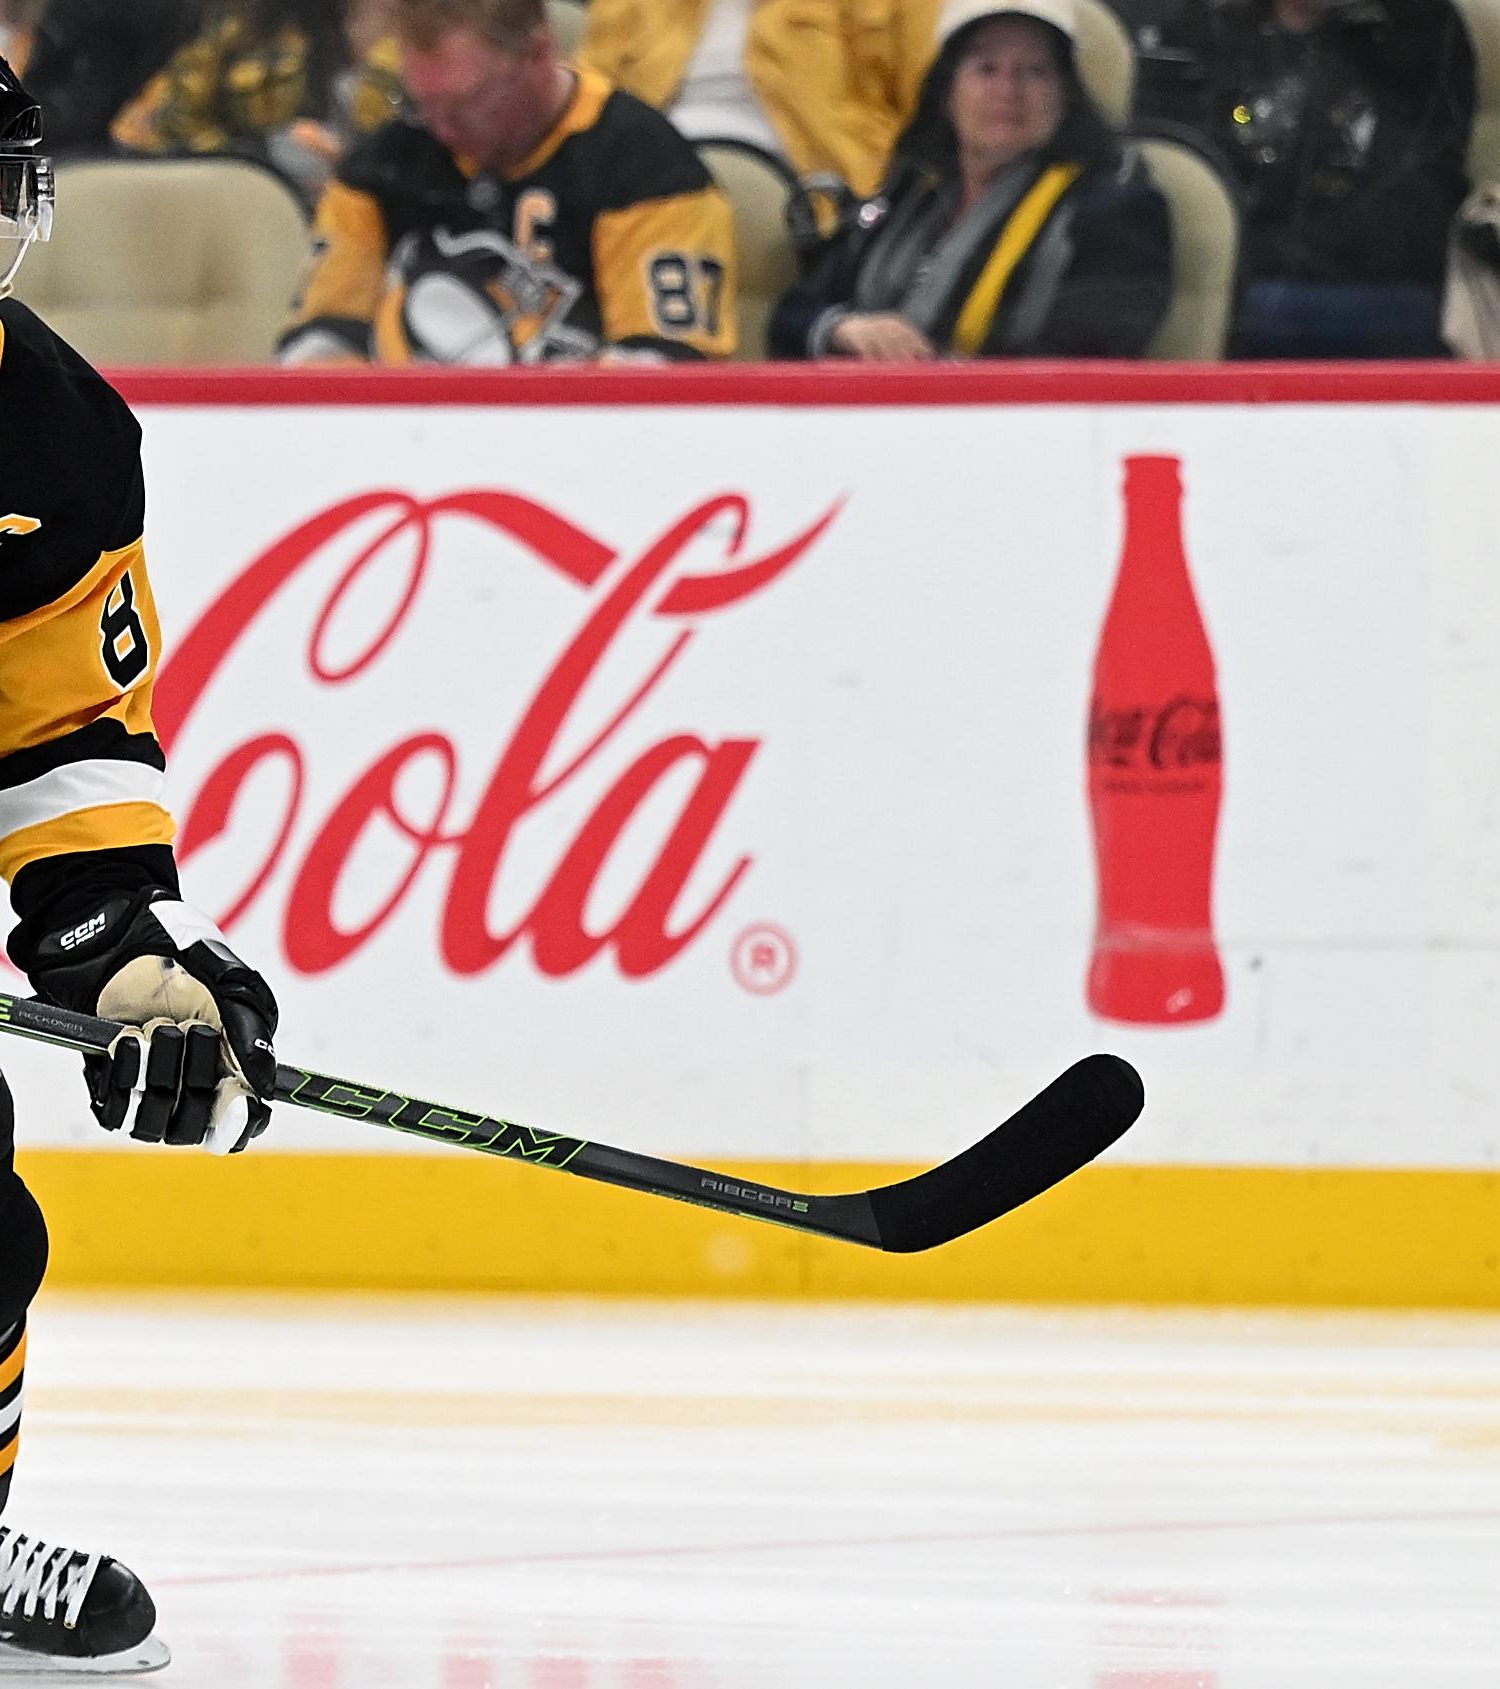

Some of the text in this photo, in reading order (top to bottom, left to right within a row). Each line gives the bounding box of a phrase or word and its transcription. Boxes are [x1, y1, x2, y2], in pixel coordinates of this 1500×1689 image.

[650, 253, 724, 334] 87
[60, 912, 106, 947] CCM
[290, 1067, 588, 1168] CCM
